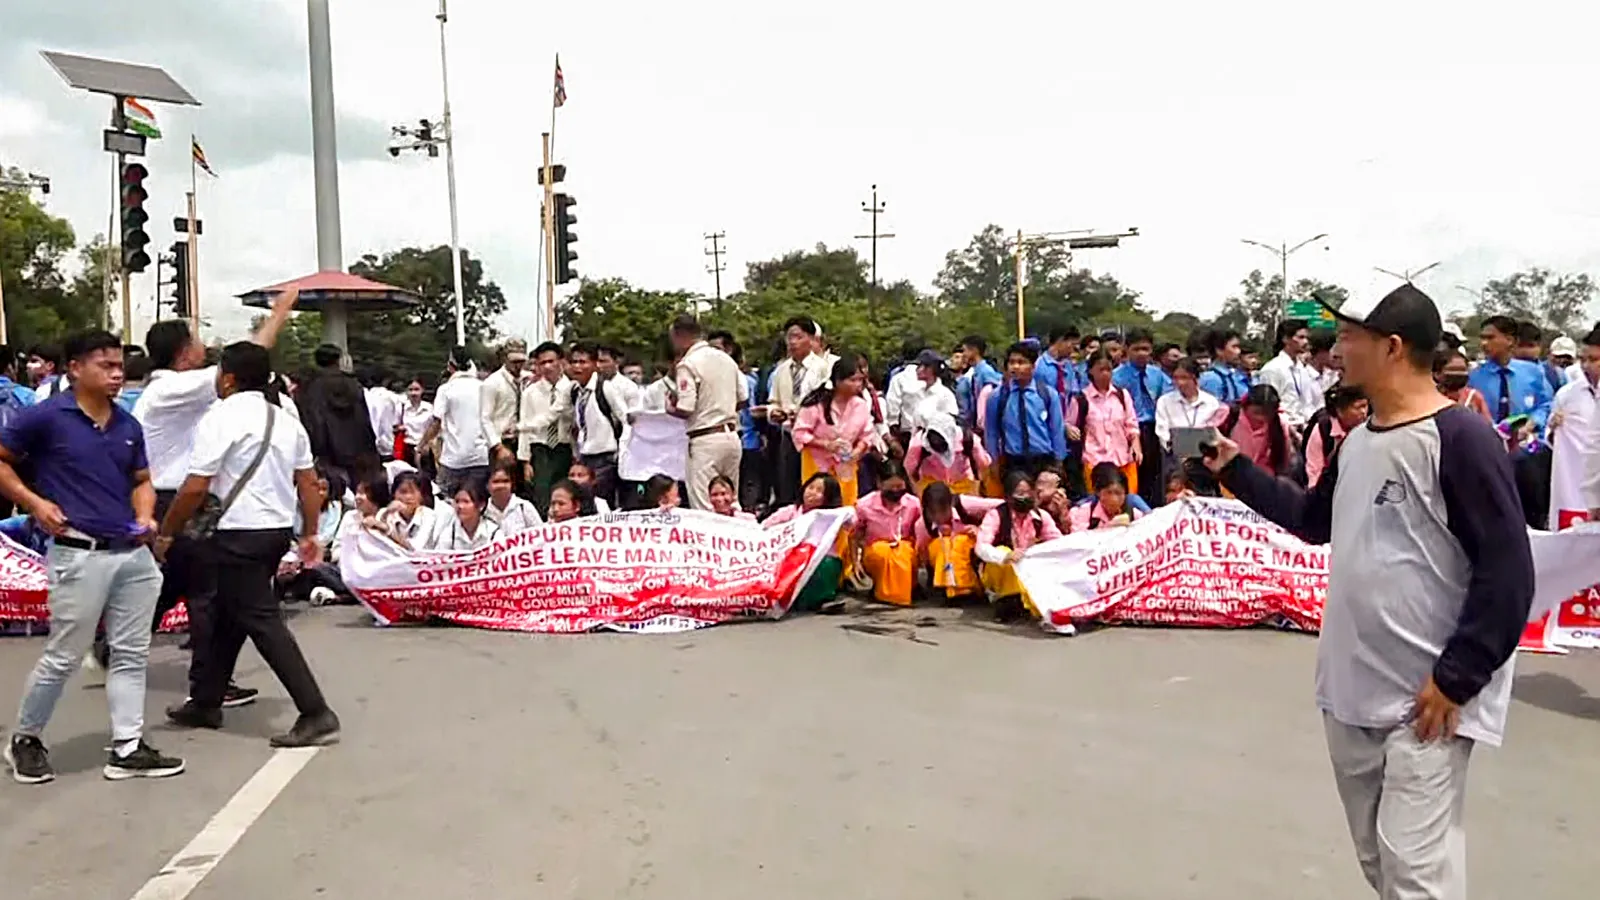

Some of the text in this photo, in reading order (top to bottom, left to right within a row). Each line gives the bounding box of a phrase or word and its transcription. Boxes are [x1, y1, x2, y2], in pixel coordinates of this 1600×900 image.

[579, 526, 622, 544] FOR
[629, 527, 661, 544] WE
[668, 527, 707, 546] ARE
[1087, 518, 1270, 576] SAVE MANIPUR FOR
[417, 549, 545, 583] OTHERWISE
[551, 546, 618, 564] LEAVE
[625, 548, 722, 568] MANPUR
[459, 580, 486, 594] THE
[488, 568, 579, 591] PARAMILITARY
[527, 585, 554, 598] DGP
[556, 583, 592, 596] MUST
[645, 578, 666, 591] ON
